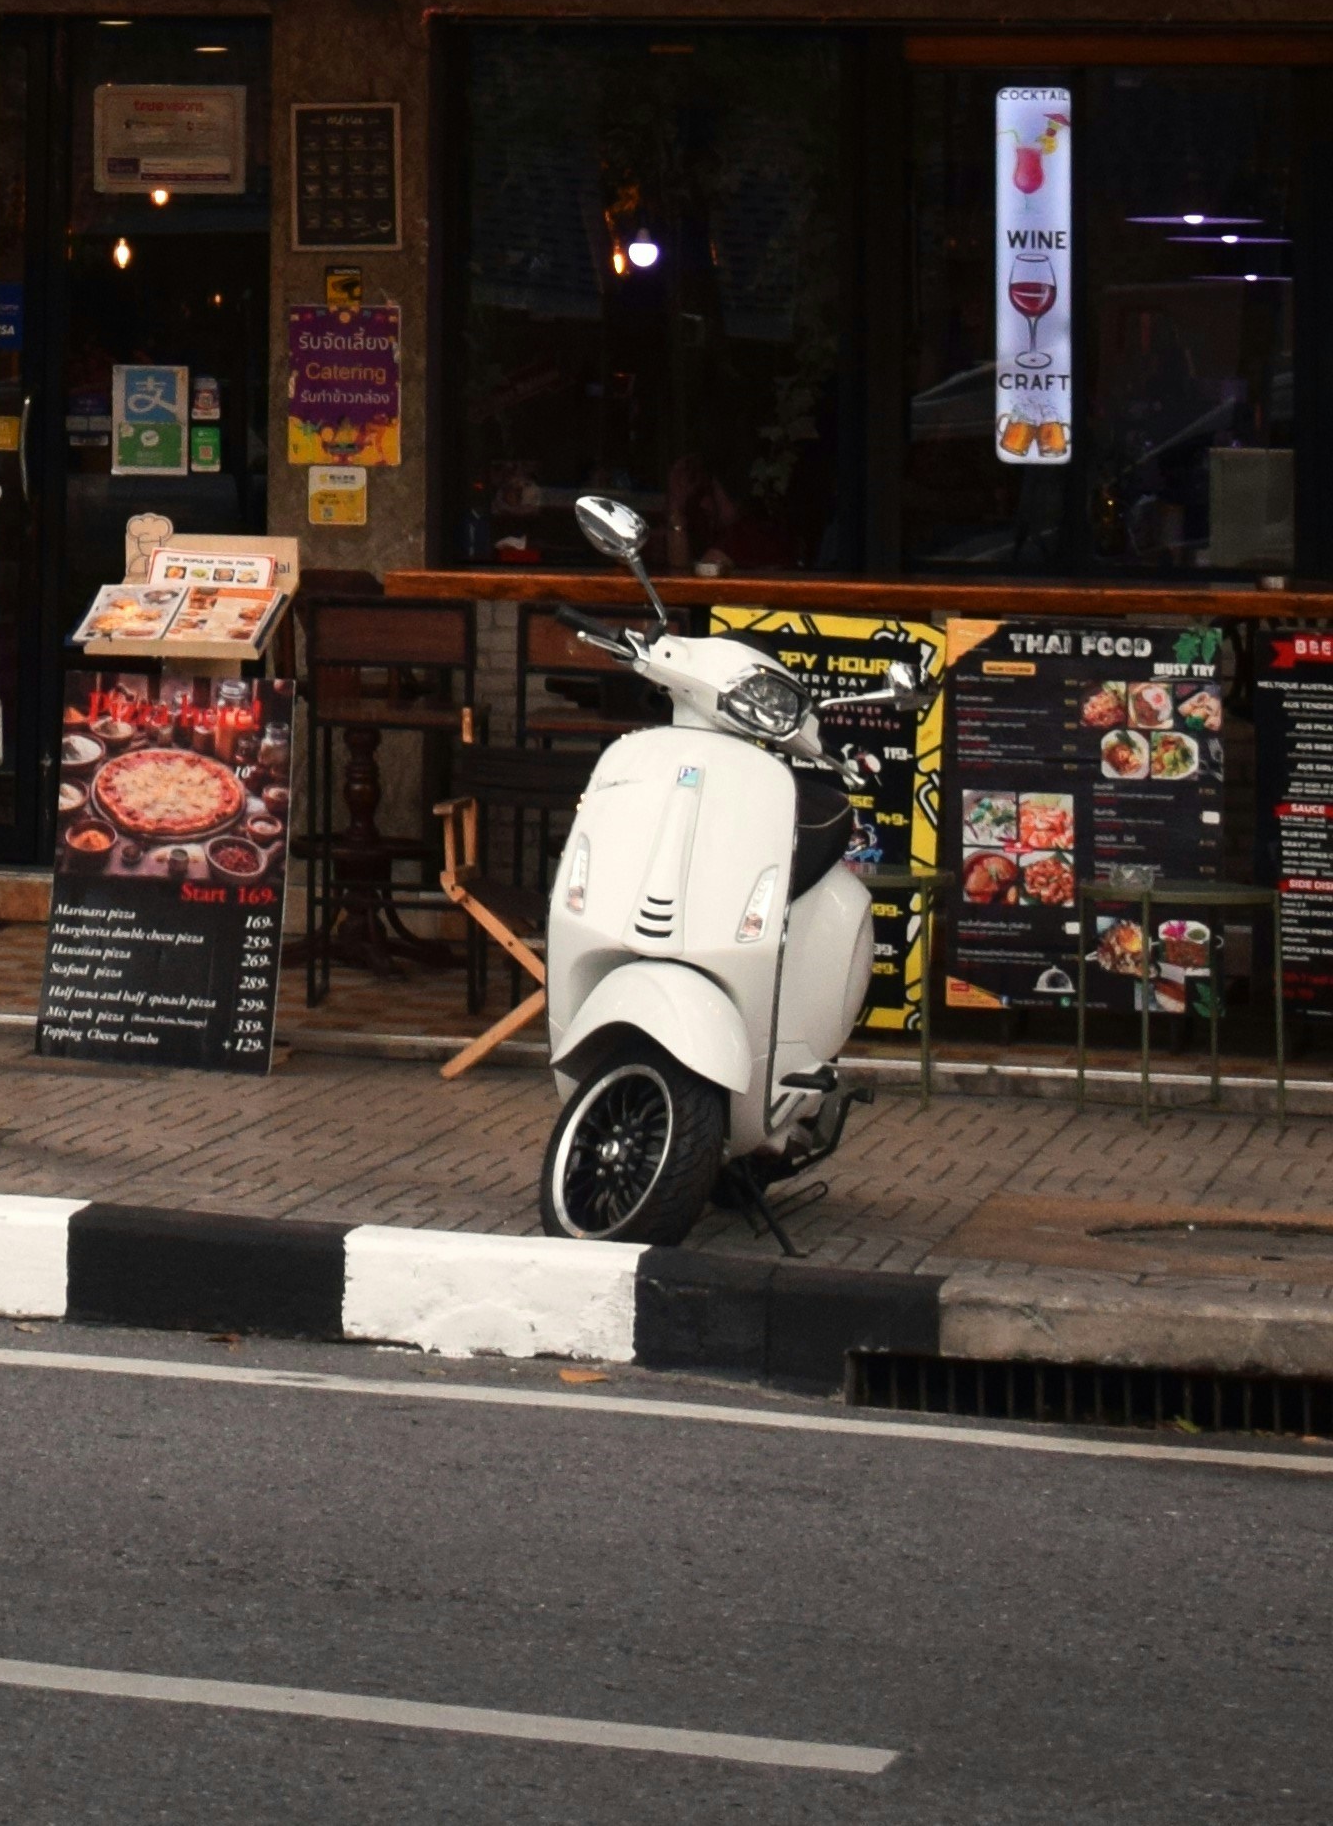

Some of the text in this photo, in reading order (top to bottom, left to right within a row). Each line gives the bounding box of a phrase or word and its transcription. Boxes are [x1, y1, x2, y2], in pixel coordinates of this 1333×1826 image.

[998, 89, 1070, 102] COCKTAIL
[1006, 229, 1067, 251] WINE
[305, 361, 387, 385] Catering
[998, 371, 1070, 393] CRAFT
[166, 555, 181, 563] TOP
[183, 557, 215, 566] POPULAR
[1009, 633, 1153, 658] THAI FOOD
[1153, 662, 1216, 677] MUST TRY
[836, 674, 869, 688] DAY
[90, 691, 262, 731] Pizza here!
[1290, 803, 1326, 814] SAUCE
[181, 883, 226, 904] Start
[1288, 878, 1313, 889] SIDE
[54, 903, 137, 922] Marinara pizza
[52, 923, 204, 946] Margherita double cheese pizza
[51, 942, 132, 961] Hawaiian pizza
[49, 961, 123, 980] Seafood pizza
[48, 985, 73, 1002] Half
[74, 989, 99, 1000] tuna
[100, 989, 122, 1001] and
[122, 989, 147, 1006] half
[186, 996, 217, 1011] pizza
[45, 1004, 125, 1024] Mix pork pizza
[42, 1024, 160, 1045] Topping Cheese Combo
